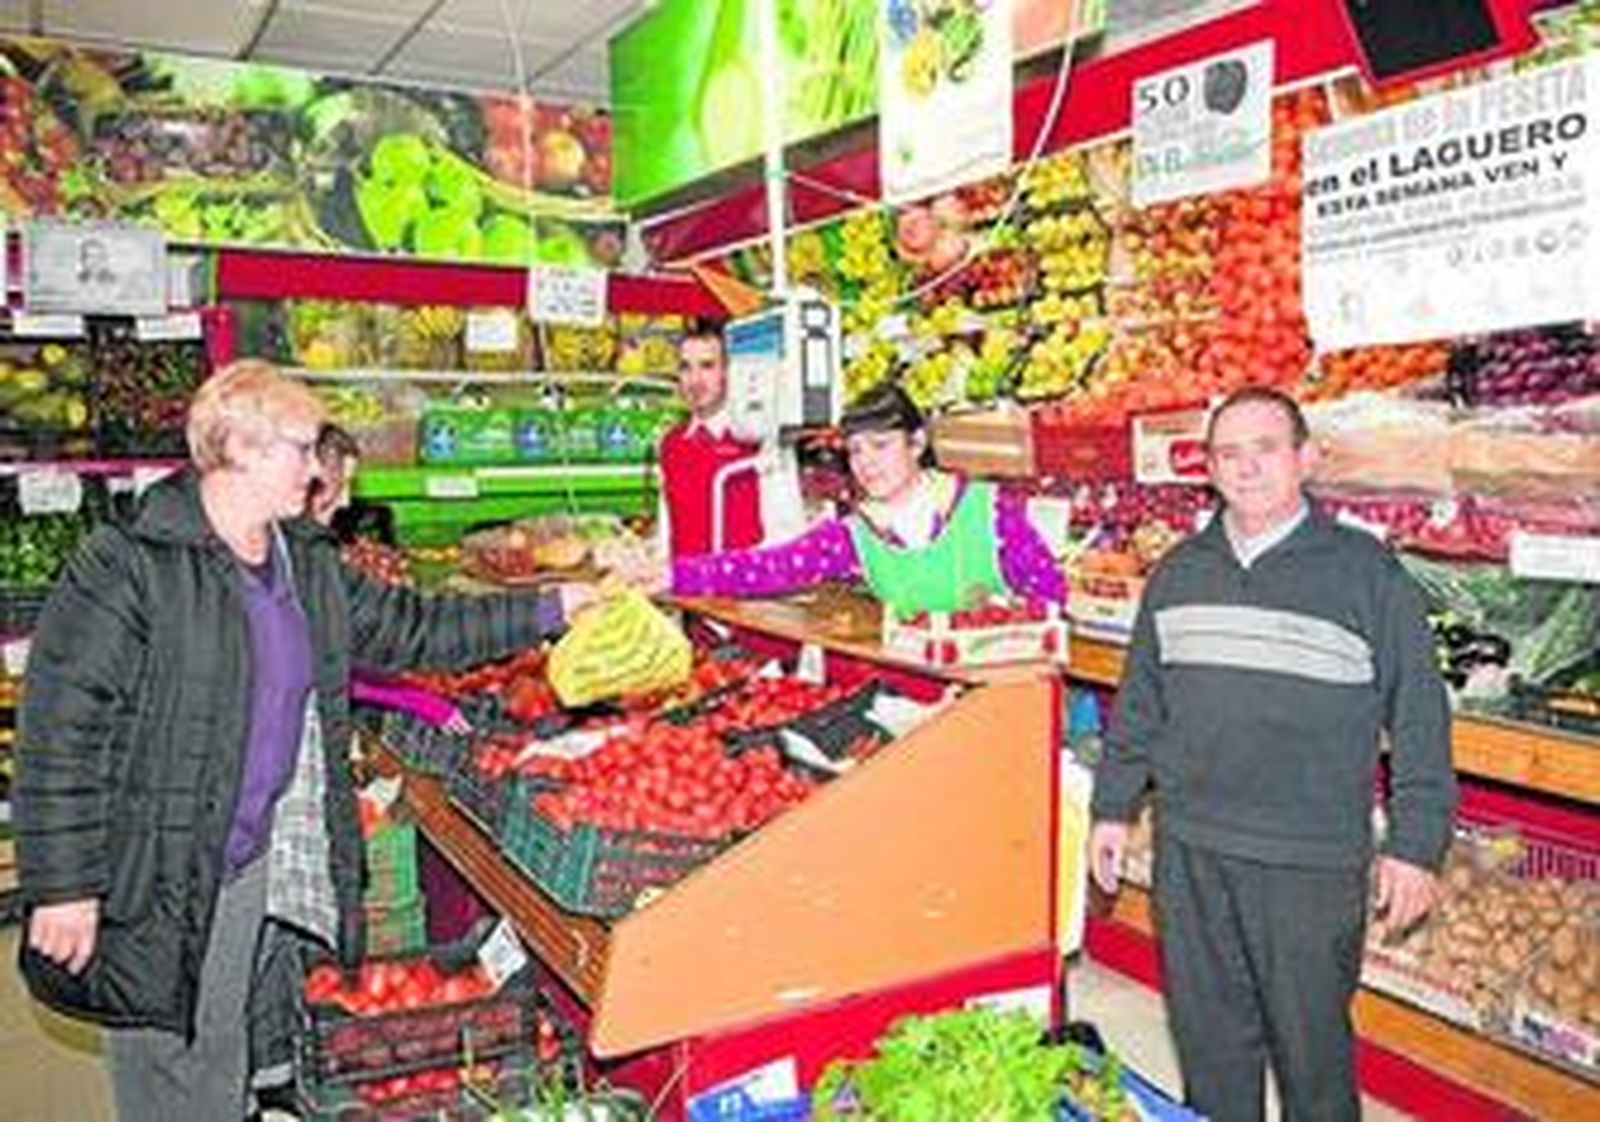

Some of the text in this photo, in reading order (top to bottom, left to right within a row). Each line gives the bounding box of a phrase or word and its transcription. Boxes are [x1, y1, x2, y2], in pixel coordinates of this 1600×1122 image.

[1306, 174, 1340, 198] en
[1350, 158, 1378, 187] el
[1317, 151, 1568, 218] ESTA SEMANA VEN Y
